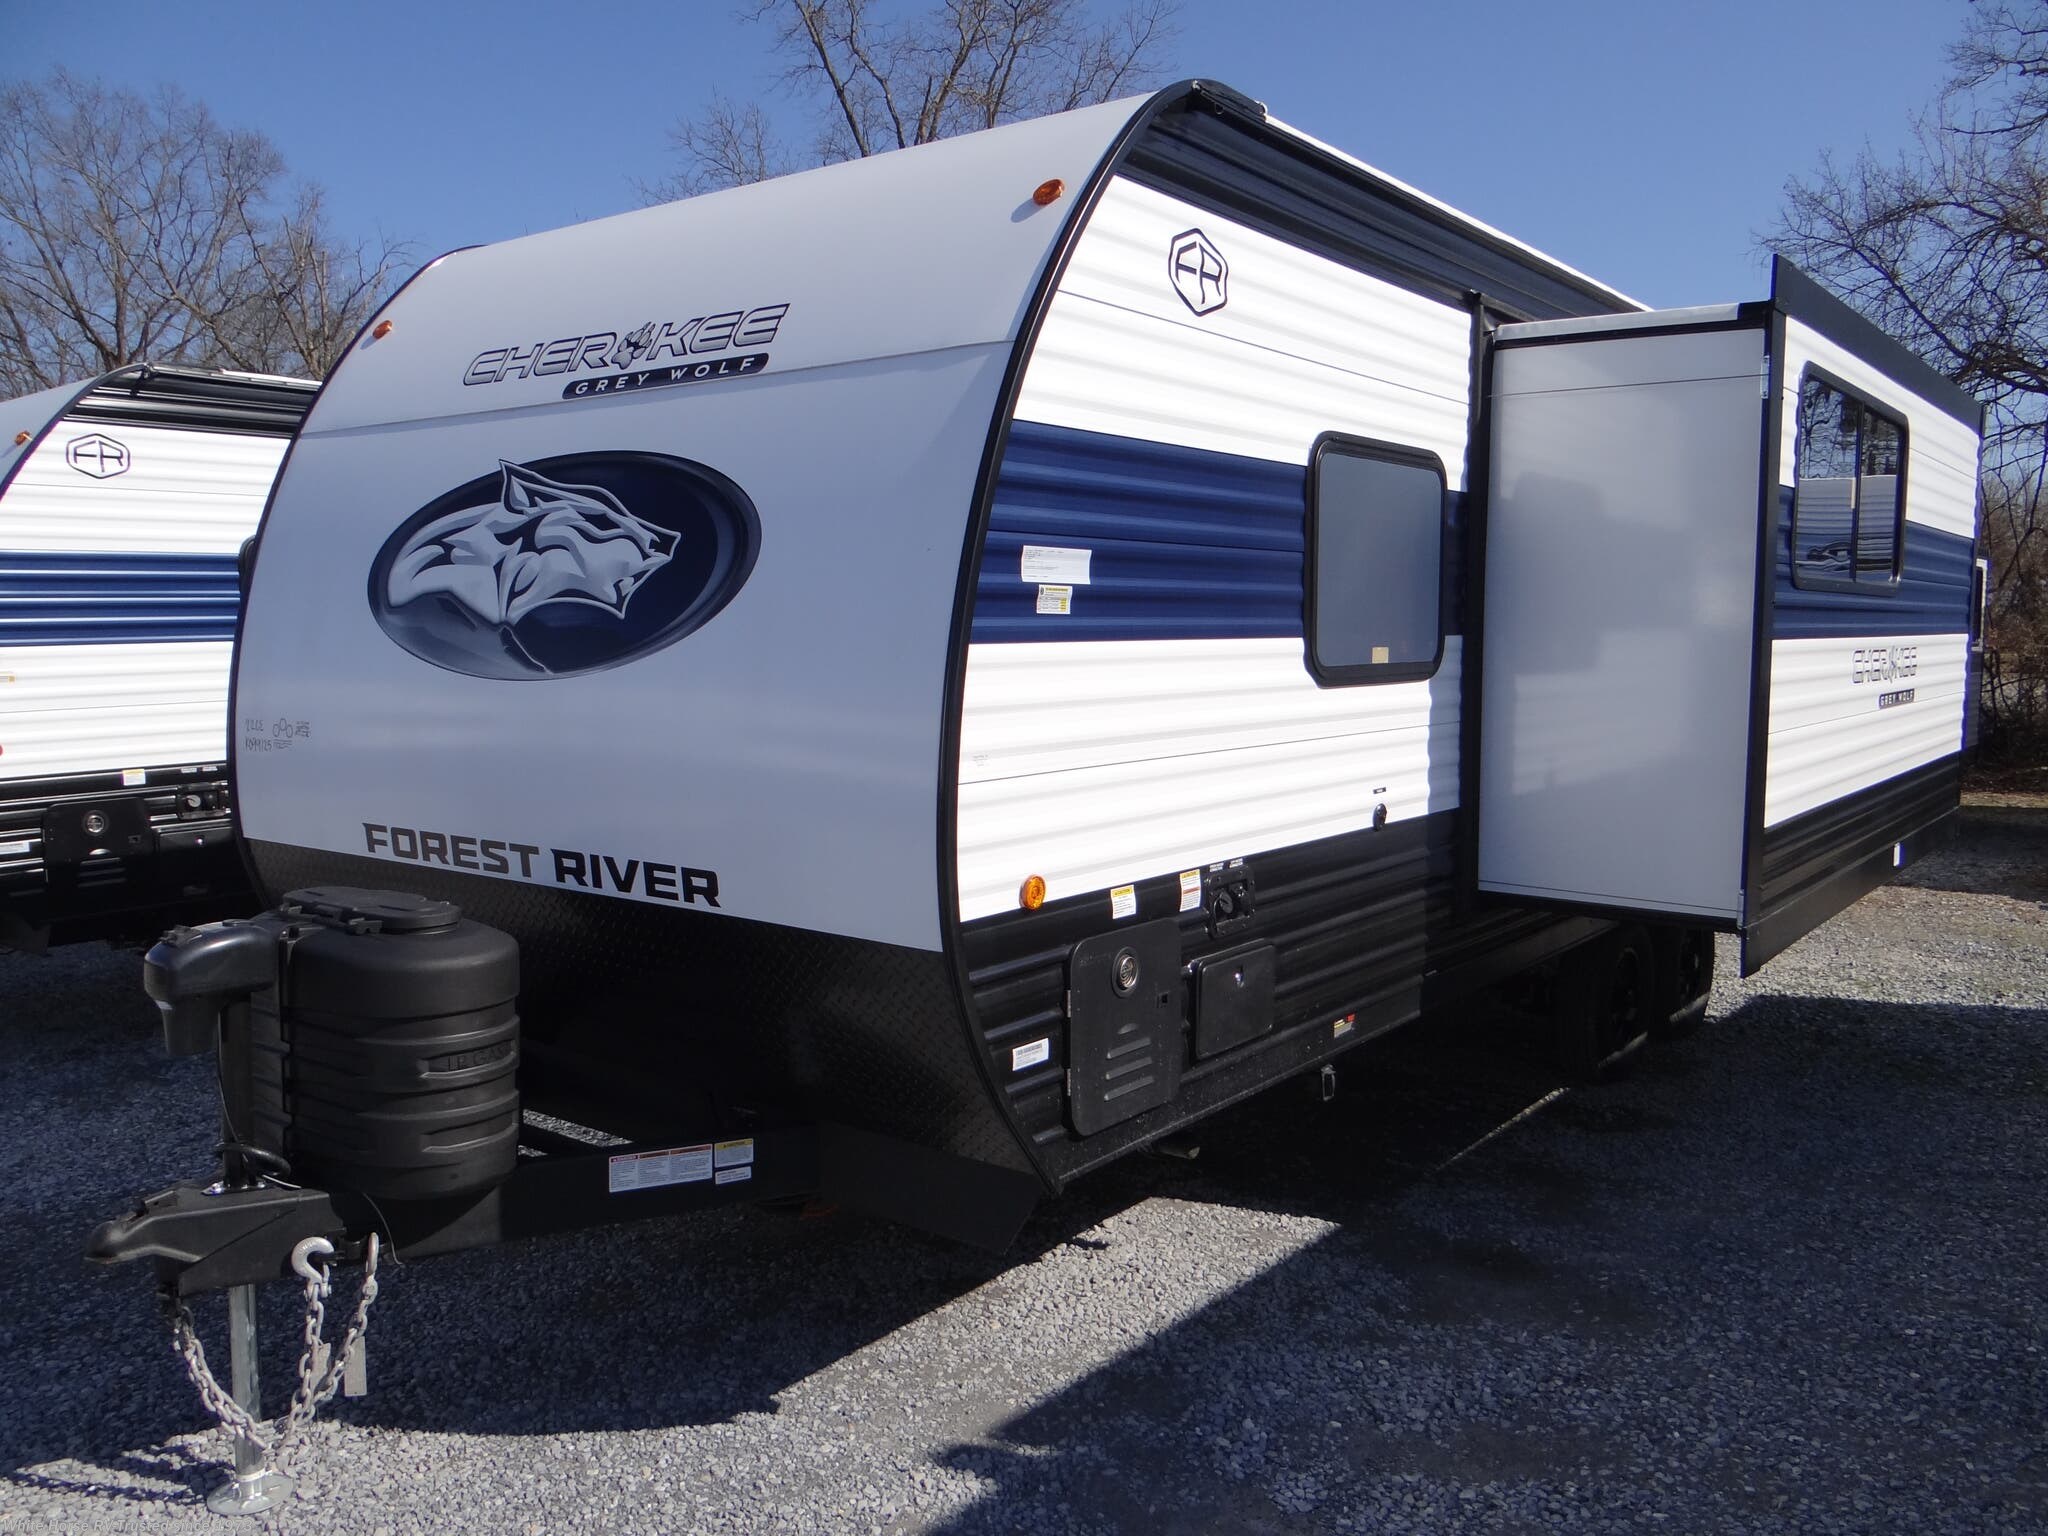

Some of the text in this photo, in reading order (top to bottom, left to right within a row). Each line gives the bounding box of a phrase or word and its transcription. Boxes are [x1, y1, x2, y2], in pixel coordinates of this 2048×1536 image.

[575, 357, 757, 396] GREY WOLF
[362, 822, 722, 908] FOREST RIVER
